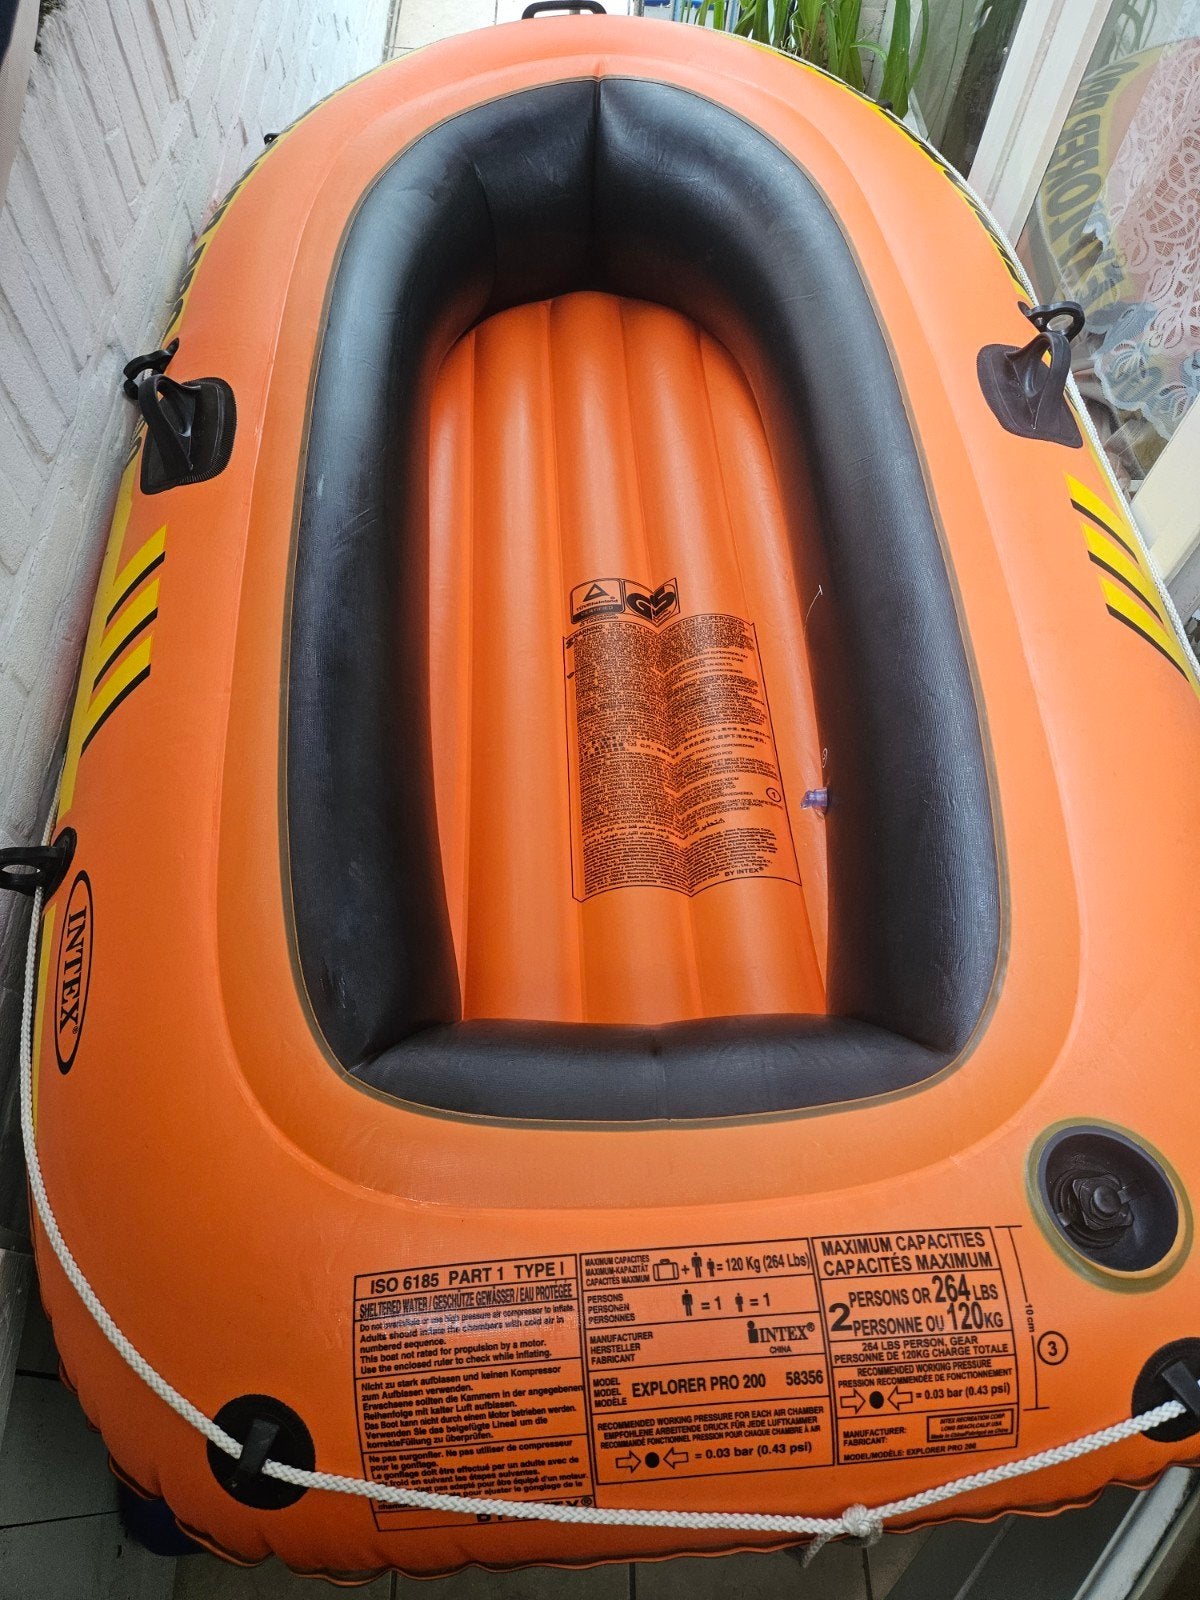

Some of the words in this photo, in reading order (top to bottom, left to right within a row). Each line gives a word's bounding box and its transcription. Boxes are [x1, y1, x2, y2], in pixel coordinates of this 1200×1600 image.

[626, 586, 676, 620] GS
[821, 1237, 892, 1256] MAXIMUM
[896, 1232, 985, 1250] CAPACITIES
[585, 1257, 613, 1266] MAXIMUM
[614, 1255, 649, 1264] CAPACITIES
[725, 1257, 743, 1271] 120
[745, 1256, 760, 1272] Kg
[763, 1254, 784, 1271] (264
[786, 1252, 810, 1269] Lbs)
[823, 1252, 912, 1276] CAPACITÉS
[915, 1252, 992, 1270] MAXIMUM
[371, 1277, 398, 1294] ISO
[403, 1273, 439, 1290] 6185
[449, 1267, 492, 1285] PART
[497, 1266, 503, 1280] 1
[514, 1262, 555, 1278] TYPE
[560, 1261, 563, 1275] I
[585, 1263, 648, 1276] MAXIMUM-KAPAZITÄT
[586, 1276, 620, 1286] CAPACITÉS
[621, 1274, 650, 1283] MAXIMUM
[587, 1293, 623, 1303] PERSONS
[848, 1289, 909, 1307] PERSONS
[912, 1287, 931, 1304] OR
[932, 1274, 971, 1303] 264
[972, 1284, 998, 1302] LBS
[714, 1296, 721, 1310] 1
[763, 1293, 769, 1306] 1
[588, 1303, 629, 1314] PERSONEN
[829, 1301, 853, 1331] 2
[1025, 1304, 1034, 1315] 10
[588, 1313, 635, 1324] PERSONNES
[852, 1316, 923, 1336] PERSONNE
[926, 1315, 944, 1332] OU
[1027, 1317, 1035, 1333] cm
[360, 1341, 402, 1353] numbered
[404, 1338, 446, 1348] sequence.
[590, 1331, 653, 1344] MANUFACTURER
[862, 1342, 878, 1351] 264
[881, 1340, 900, 1350] LBS
[950, 1335, 978, 1346] GEAR
[360, 1355, 378, 1363] This
[380, 1353, 398, 1361] boat
[400, 1351, 414, 1359] not
[416, 1348, 438, 1357] rated
[440, 1347, 451, 1355] for
[454, 1343, 498, 1355] propulsion
[500, 1342, 510, 1350] by
[520, 1339, 546, 1347] motor.
[590, 1342, 640, 1354] HERSTELLER
[769, 1345, 792, 1354] CHINA
[833, 1352, 884, 1363] PERSONNE
[886, 1351, 898, 1360] DE
[901, 1349, 929, 1359] 120KG
[932, 1346, 970, 1357] CHARGE
[972, 1343, 1008, 1354] TOTALE
[360, 1366, 376, 1374] Use
[378, 1364, 392, 1372] the
[393, 1359, 431, 1370] enclosed
[434, 1358, 453, 1366] ruler
[465, 1354, 490, 1363] check
[492, 1352, 514, 1361] while
[516, 1349, 551, 1359] inflating.
[591, 1354, 635, 1364] FABRICANT
[857, 1364, 914, 1376] RECOMMENDED
[915, 1362, 951, 1372] WORKING
[952, 1358, 992, 1370] PRESSURE
[361, 1382, 383, 1390] Nicht
[397, 1378, 418, 1387] stark
[420, 1375, 460, 1385] aufblasen
[463, 1372, 479, 1381] und
[481, 1371, 508, 1379] keinen
[510, 1366, 561, 1376] Kompressor
[593, 1377, 620, 1387] MODEL
[632, 1377, 706, 1397] EXPLORER
[710, 1374, 739, 1390] PRO
[742, 1373, 766, 1388] 200
[786, 1370, 823, 1386] 58356
[838, 1379, 875, 1388] PRESSION
[876, 1373, 933, 1385] RECOMMENDÉE
[946, 1368, 1012, 1380] FONCTIONNEMENT
[593, 1388, 621, 1397] MODEL
[924, 1389, 944, 1399] 0.03
[946, 1388, 963, 1397] bar
[965, 1385, 988, 1398] (0.43
[990, 1382, 1010, 1396] psi)
[594, 1397, 627, 1407] MODÈLE
[597, 1418, 655, 1430] RECOMMENDED
[656, 1415, 692, 1425] WORKING
[693, 1412, 733, 1422] PRESSURE
[751, 1410, 771, 1418] EACH
[774, 1408, 786, 1416] AIR
[787, 1406, 823, 1415] CHAMBER
[603, 1428, 653, 1439] EMPFOHLENE
[655, 1424, 701, 1435] ARBEITENDE
[703, 1422, 729, 1431] DRUCK
[747, 1419, 766, 1428] JEDE
[767, 1416, 817, 1426] LUFTKAMMER
[705, 1448, 730, 1458] 0.03
[734, 1447, 753, 1456] bar
[757, 1444, 786, 1457] (0.43
[790, 1441, 812, 1454] psi)
[906, 1446, 945, 1455] EXPLORER
